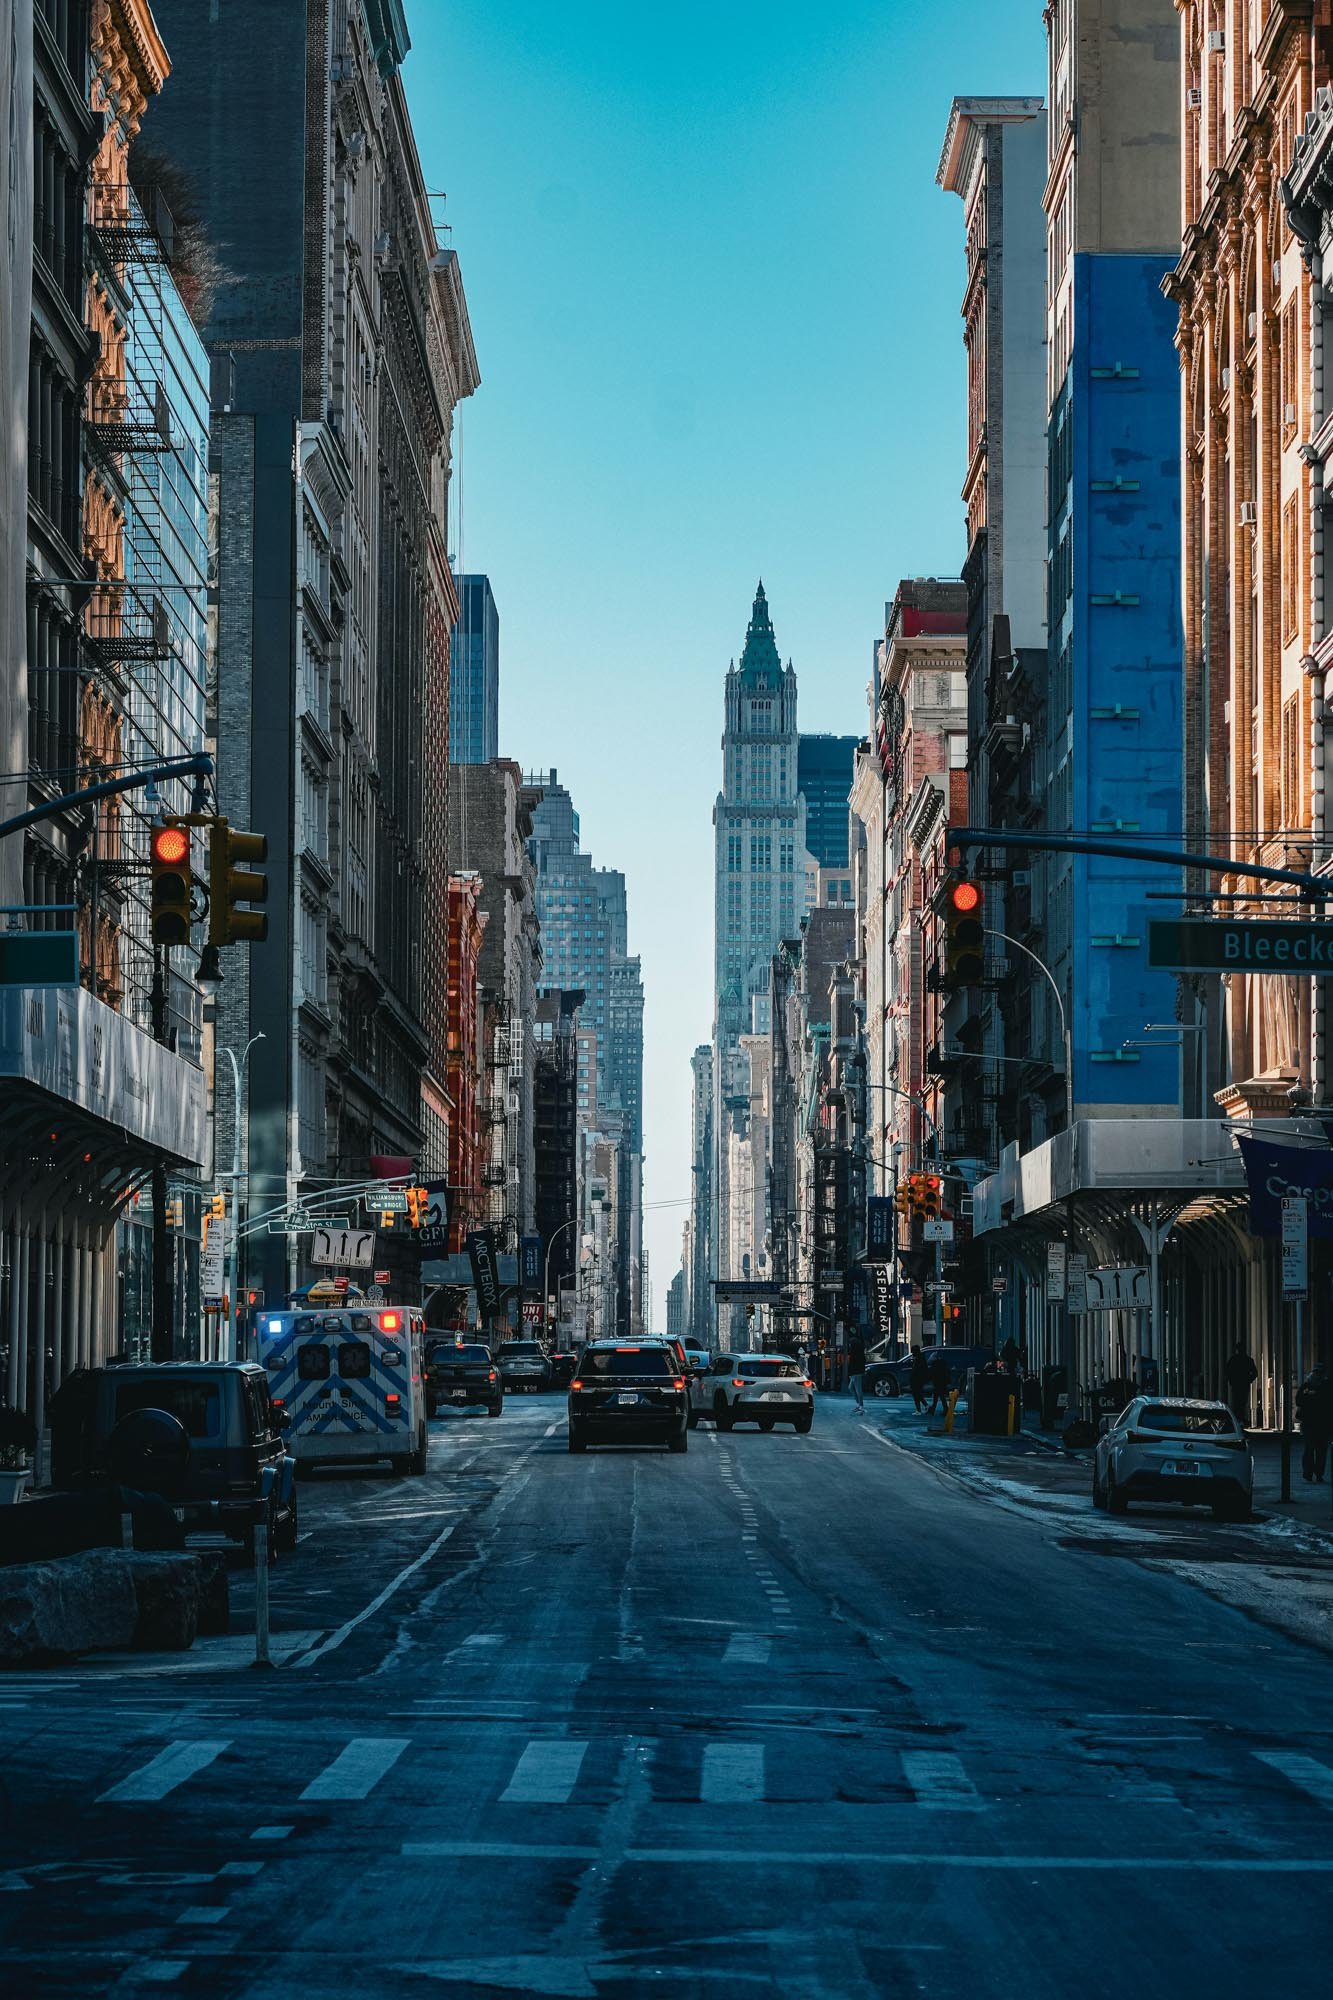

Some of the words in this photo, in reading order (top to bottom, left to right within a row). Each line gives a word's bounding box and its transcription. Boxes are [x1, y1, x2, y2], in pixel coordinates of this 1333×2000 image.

[1266, 1176, 1333, 1210] Casp
[876, 1270, 889, 1332] SEPHORA
[522, 1304, 540, 1315] UNI
[302, 1400, 337, 1410] Mount
[341, 1399, 368, 1408] Sinai
[306, 1411, 367, 1422] AMBULANCE
